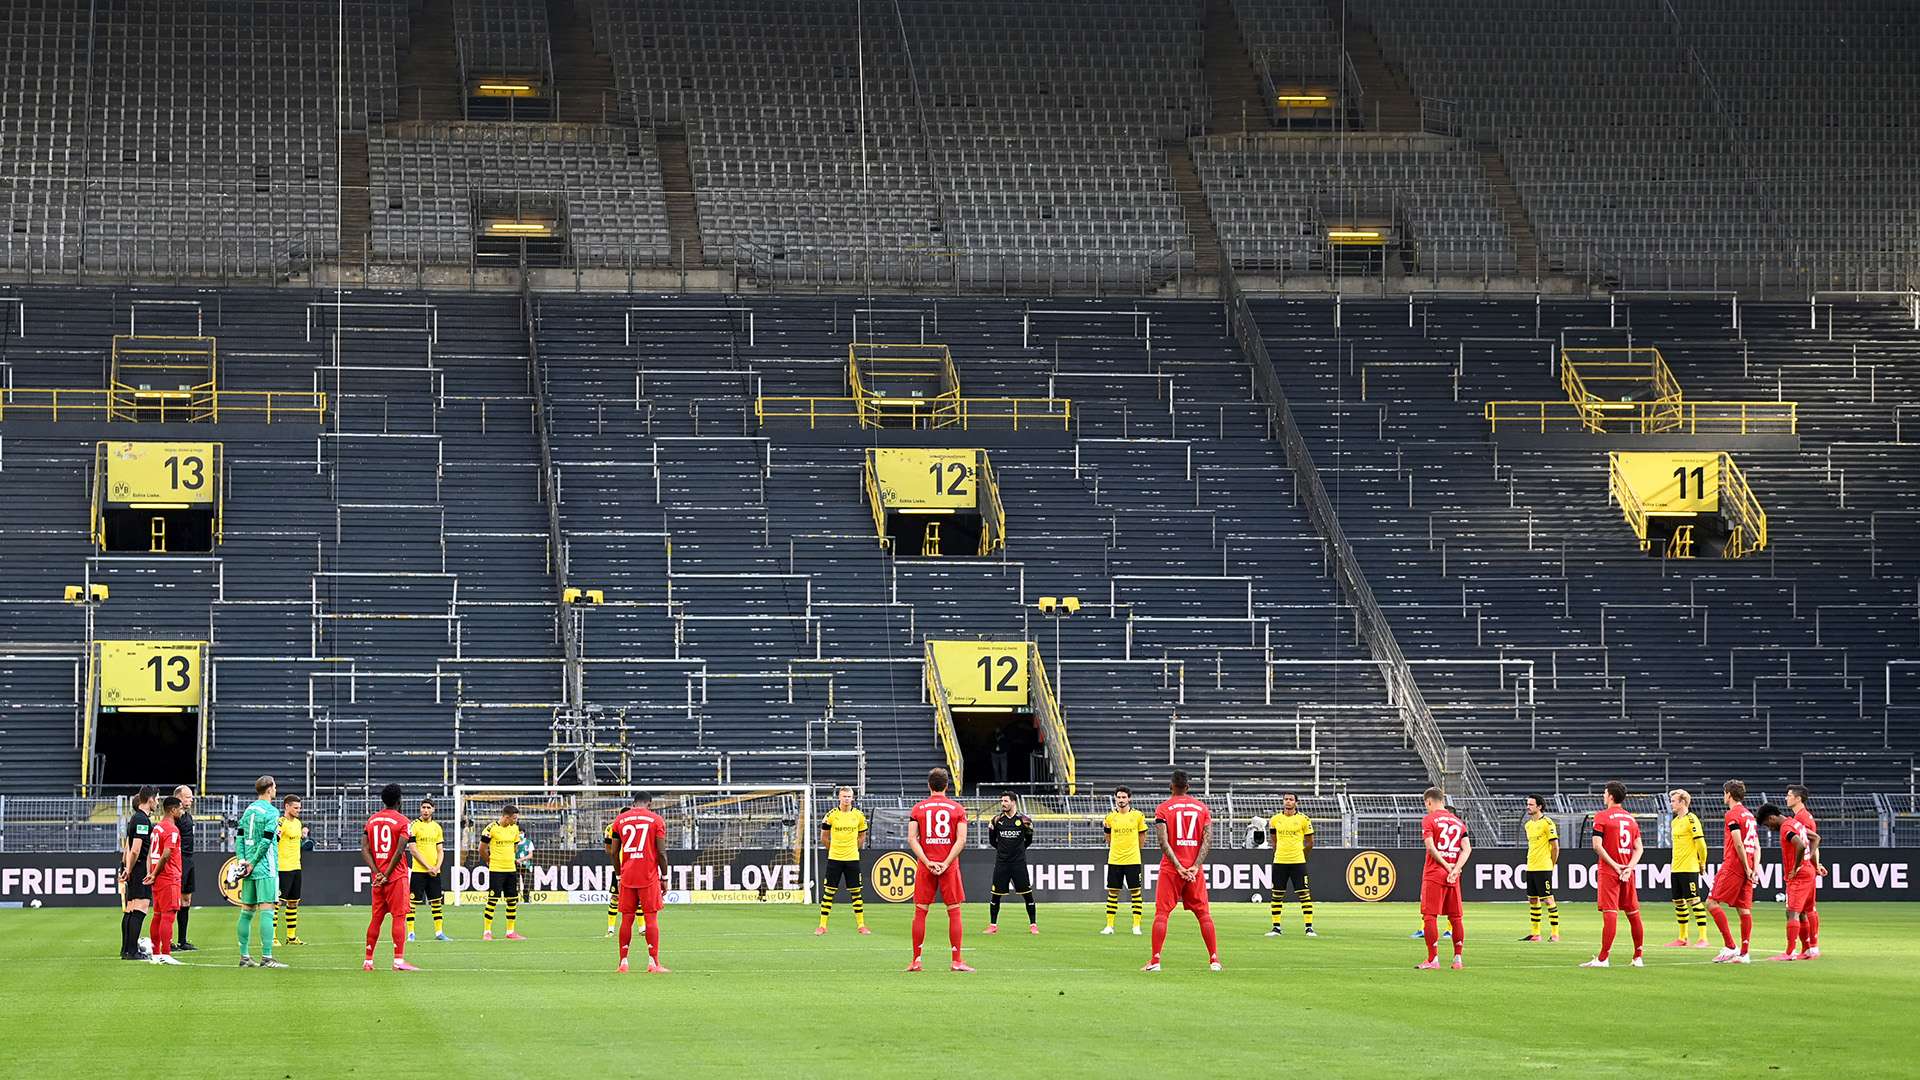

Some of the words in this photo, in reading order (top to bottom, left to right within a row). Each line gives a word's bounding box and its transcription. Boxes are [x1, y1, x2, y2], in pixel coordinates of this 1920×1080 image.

[164, 456, 204, 490] 13
[929, 463, 967, 495] 12
[1673, 467, 1704, 499] 11
[115, 483, 129, 494] BVB
[882, 489, 896, 500] BVB
[147, 656, 190, 692] 13
[977, 656, 1018, 691] 12
[249, 813, 255, 840] 1
[622, 823, 649, 852] 27
[926, 810, 950, 838] 18
[1176, 811, 1198, 839] 17
[1437, 822, 1461, 852] 32
[1619, 820, 1631, 848] 5
[373, 825, 392, 852] 19
[2, 868, 121, 895] FRIEDE
[723, 864, 801, 890] LOVE
[880, 858, 915, 887] BVB
[1354, 857, 1389, 886] BVB
[1832, 863, 1909, 889] LOVE
[533, 892, 548, 902] 09
[579, 893, 608, 902] SIGN
[777, 891, 791, 900] 09
[890, 886, 904, 897] 09
[1364, 886, 1378, 896] 09
